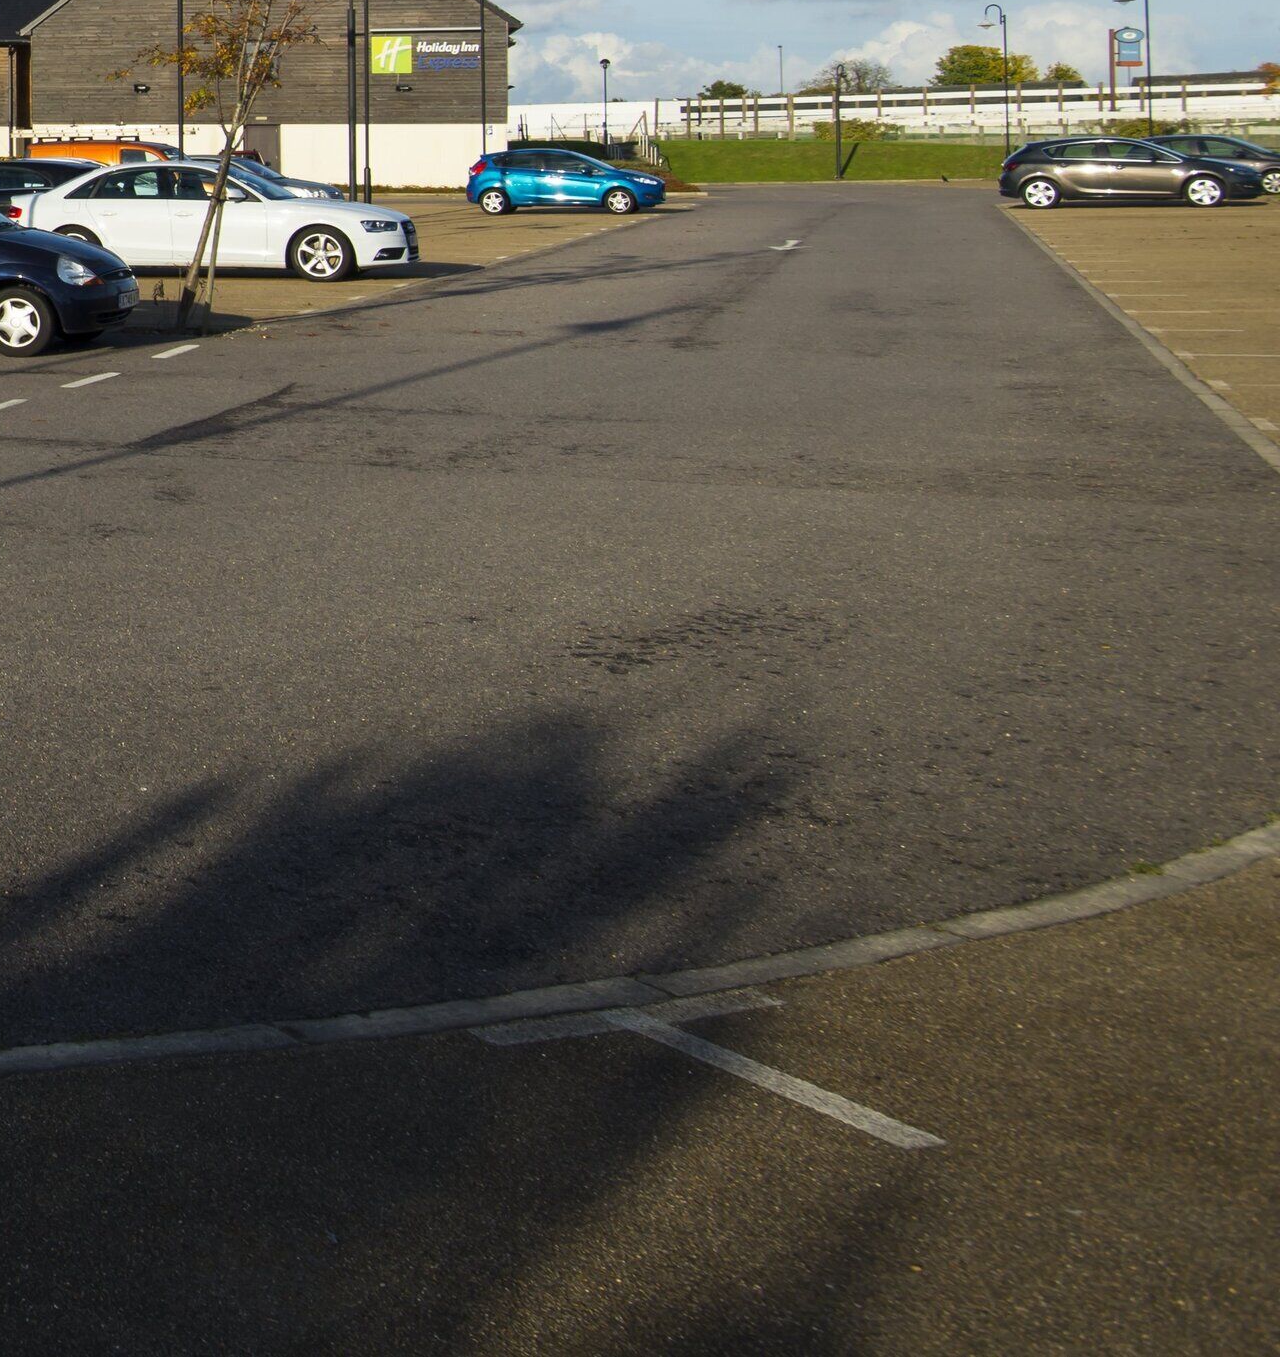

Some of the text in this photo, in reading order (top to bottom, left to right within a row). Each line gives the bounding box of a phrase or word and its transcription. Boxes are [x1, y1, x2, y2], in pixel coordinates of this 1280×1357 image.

[416, 41, 479, 55] Holiday Inn
[417, 53, 478, 70] Express
